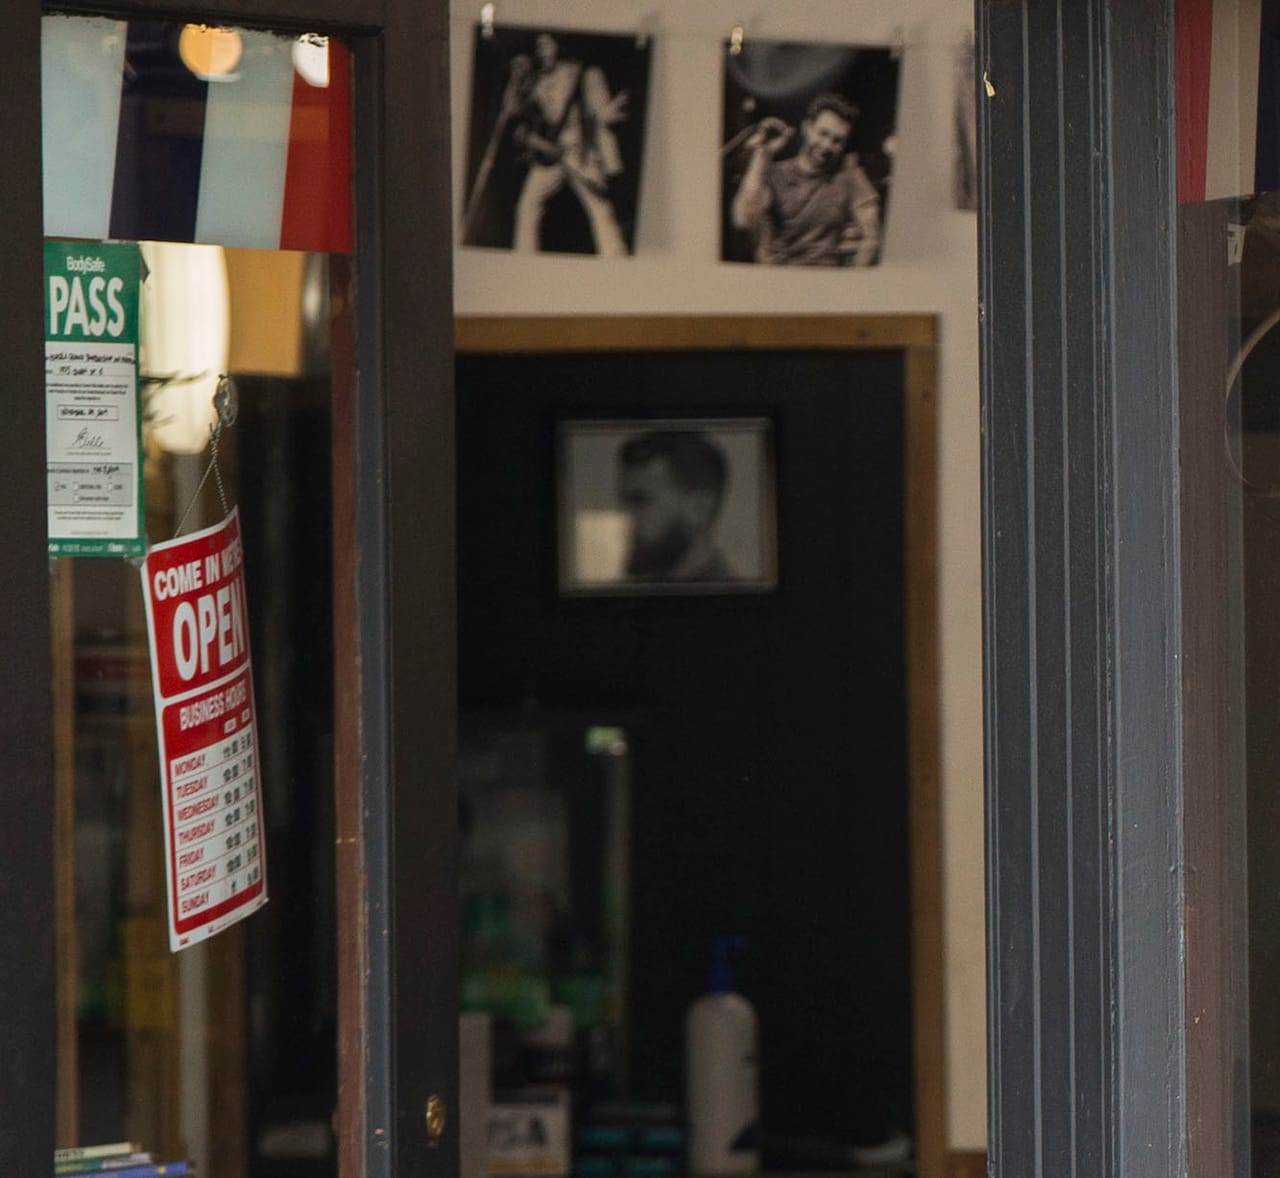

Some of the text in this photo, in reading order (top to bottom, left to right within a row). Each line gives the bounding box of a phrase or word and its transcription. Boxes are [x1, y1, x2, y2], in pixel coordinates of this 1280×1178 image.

[66, 256, 106, 274] BodySafe
[49, 275, 125, 337] PASS
[154, 559, 202, 601] COME
[205, 553, 220, 585] IN
[173, 578, 245, 681] OPEN
[179, 691, 225, 731] BUSINESS
[174, 754, 206, 776] MONDAY
[176, 777, 208, 798] TUESDAY
[178, 795, 220, 821] WEDNESDAY
[179, 820, 215, 844] THURSDAY
[179, 847, 204, 868] FRIDAY
[181, 865, 216, 892] SATURDAY
[182, 892, 210, 914] SUNDAY
